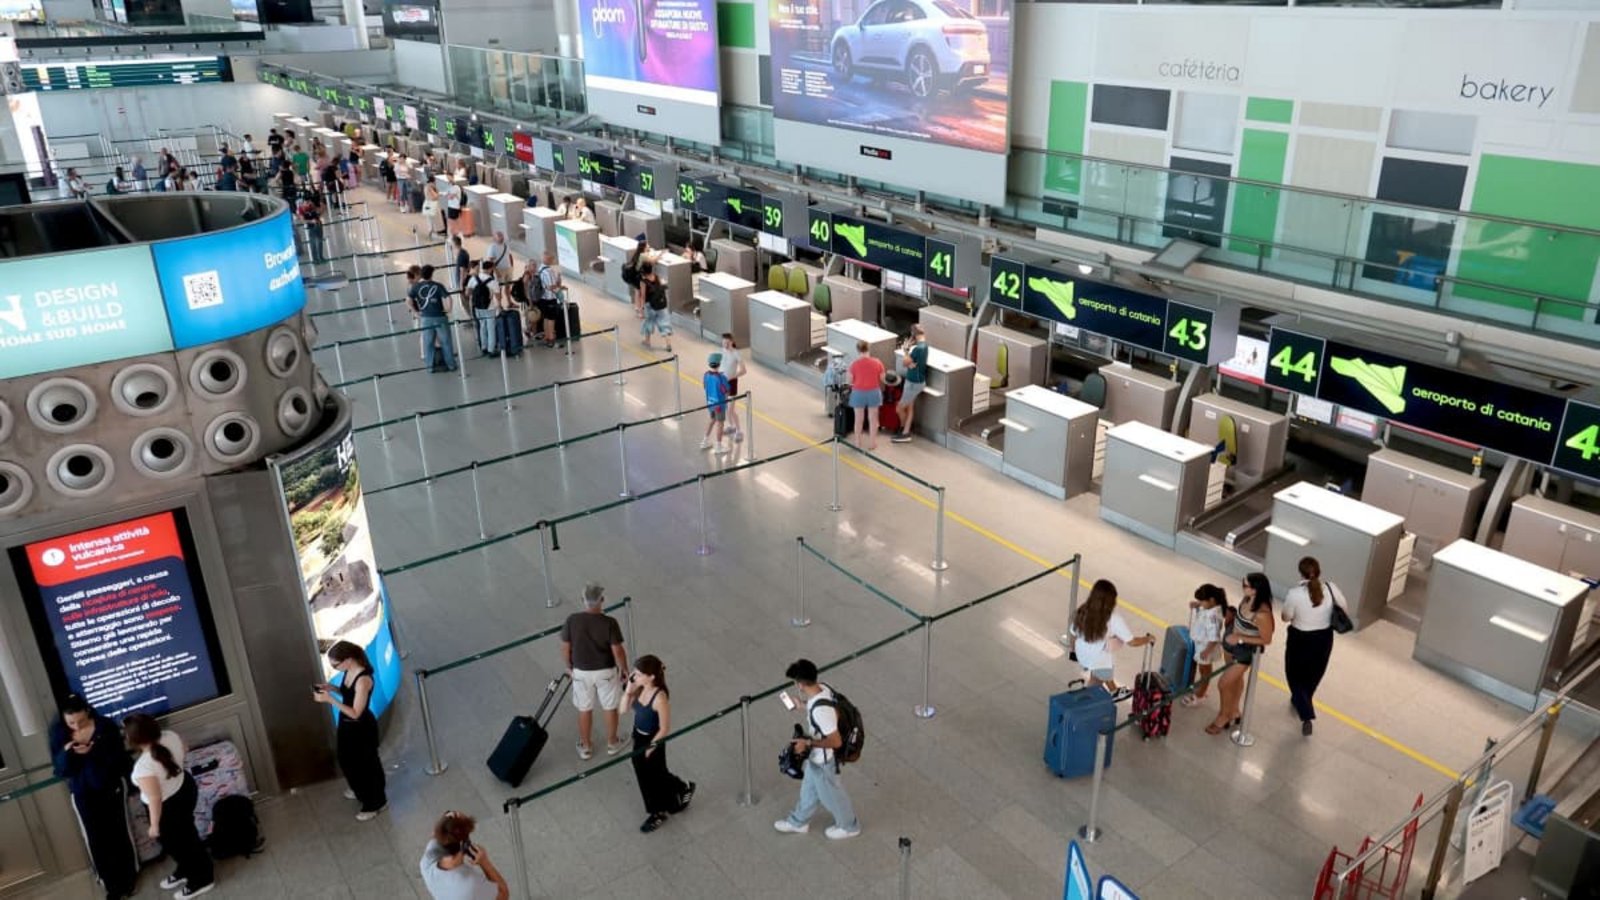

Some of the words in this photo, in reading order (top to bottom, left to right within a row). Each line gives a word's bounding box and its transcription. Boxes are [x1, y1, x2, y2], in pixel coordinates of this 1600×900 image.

[592, 5, 625, 38] ploom
[1158, 59, 1240, 83] cafétéria
[1460, 74, 1555, 108] bakery
[505, 137, 514, 152] 35
[578, 156, 591, 174] 36
[640, 172, 653, 192] 37
[680, 183, 695, 204] 38
[764, 207, 782, 228] 39
[810, 219, 830, 243] 40
[930, 252, 951, 279] 41
[34, 282, 119, 308] DESIGN
[993, 270, 1020, 299] 42
[42, 301, 123, 327] &BUILD
[1078, 298, 1117, 315] aeroporto
[1119, 306, 1128, 317] di
[1128, 311, 1161, 326] catania
[46, 327, 77, 341] SUD
[82, 319, 127, 336] HOME
[1169, 318, 1208, 351] 43
[1269, 345, 1317, 382] 44
[1412, 386, 1478, 413] aeroporto
[1480, 402, 1495, 416] di
[1496, 407, 1552, 432] catania
[1566, 424, 1600, 460] 4
[69, 536, 111, 552] Intensa
[113, 526, 150, 543] attività
[72, 543, 125, 562] vulcanica
[97, 606, 140, 622] operazioni
[151, 596, 180, 607] decollo
[118, 621, 157, 635] lavorando
[160, 616, 171, 625] per
